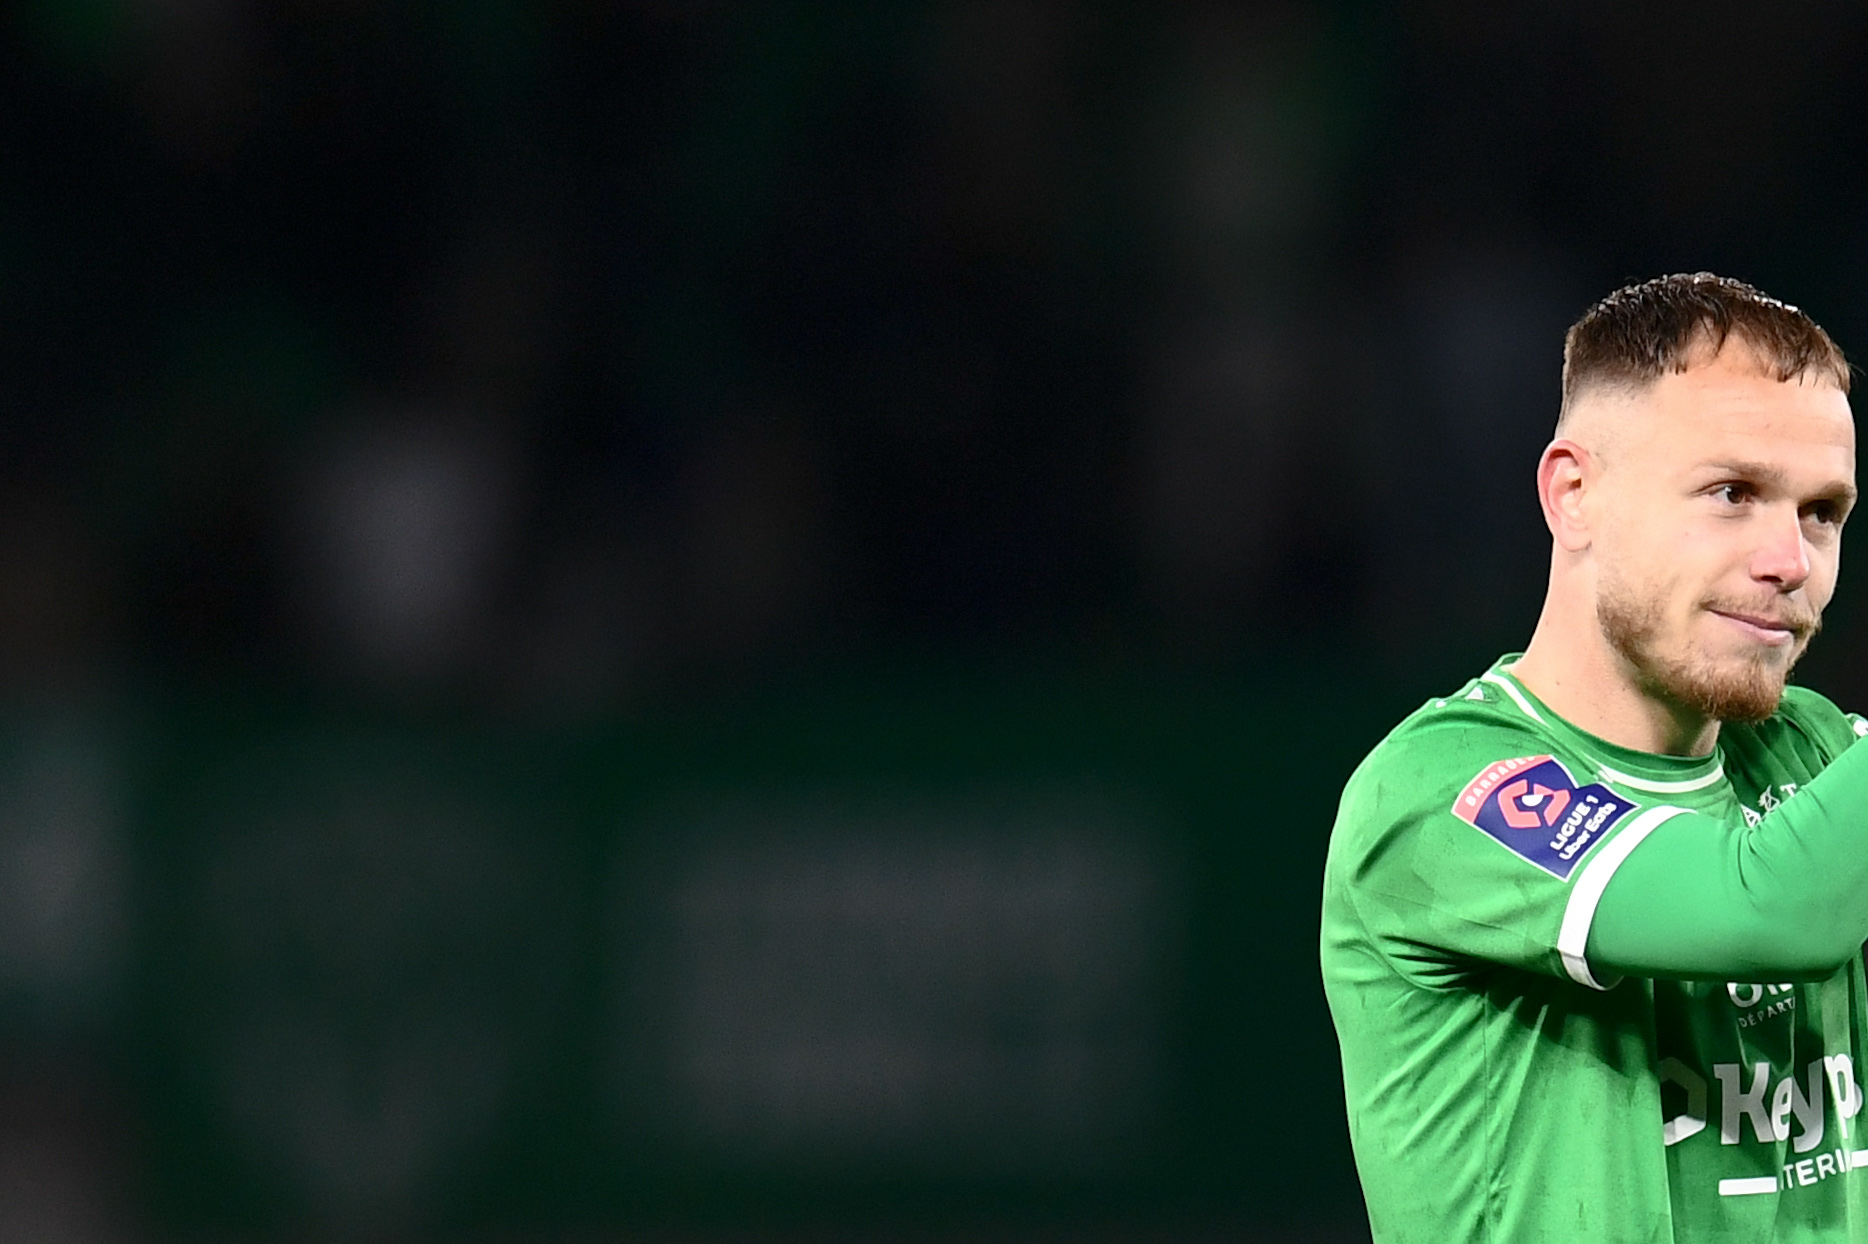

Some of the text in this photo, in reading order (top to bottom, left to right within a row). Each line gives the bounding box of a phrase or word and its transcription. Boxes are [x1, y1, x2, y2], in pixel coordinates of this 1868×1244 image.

[1550, 795, 1599, 850] LIGUE 1
[1559, 803, 1617, 860] Uber Eats
[1738, 996, 1796, 1028] DÉPART
